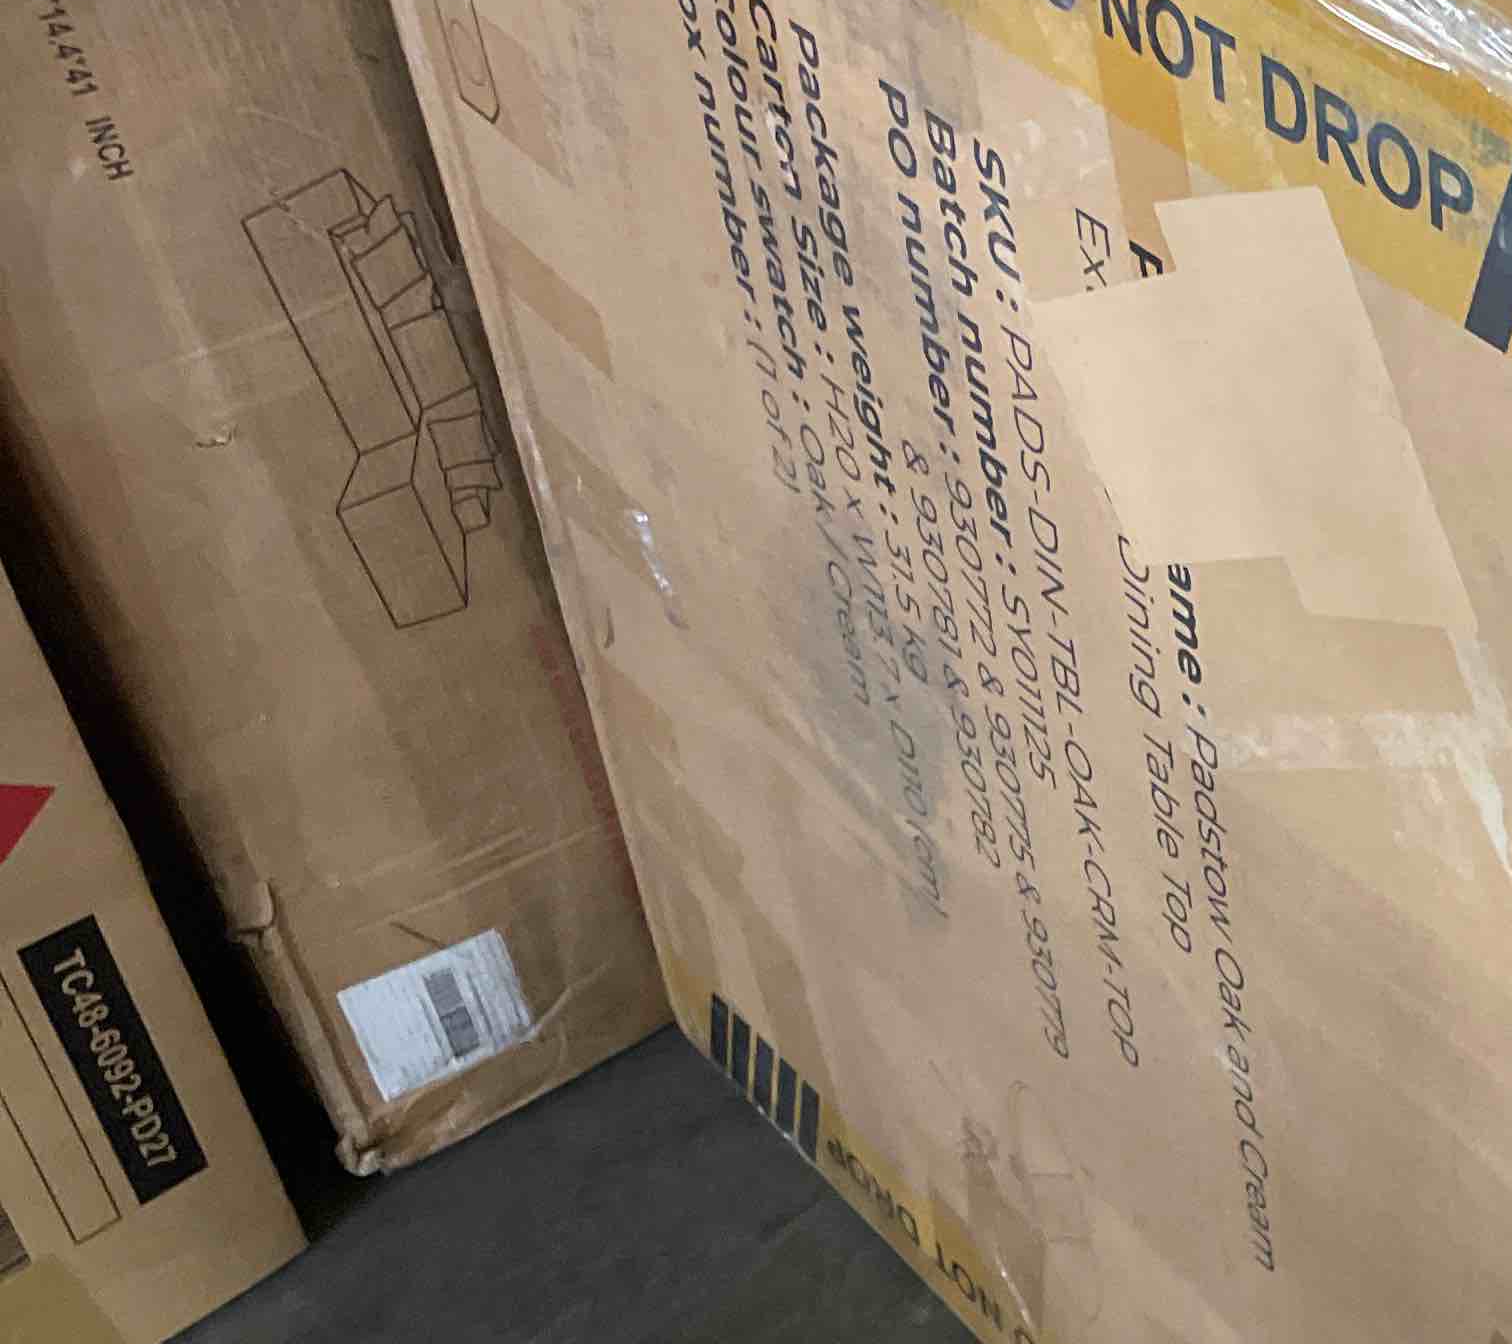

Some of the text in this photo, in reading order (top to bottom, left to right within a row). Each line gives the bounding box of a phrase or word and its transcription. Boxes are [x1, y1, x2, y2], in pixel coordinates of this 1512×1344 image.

[85, 115, 134, 182] INCH
[878, 78, 919, 181] PO
[1259, 53, 1475, 233] DROP
[694, 71, 757, 304] number
[761, 389, 793, 450] of
[788, 17, 855, 289] Package
[842, 304, 897, 496] weight
[883, 529, 921, 622] 31.5
[897, 191, 958, 438] number
[925, 109, 979, 297] Batch
[953, 309, 1012, 549] number
[750, 175, 808, 381] swatch
[799, 423, 836, 522] Oak
[827, 559, 871, 708] Cream
[820, 372, 861, 482] H20
[944, 472, 997, 657] 930772
[973, 138, 1021, 282] SKU
[1000, 326, 1139, 1067] PADS-DIN-TBL-OAK-CRM-TOP
[1166, 562, 1203, 685] ame
[910, 488, 963, 659] 930781
[950, 703, 1001, 869] 930782
[984, 705, 1037, 874] 930775
[1139, 730, 1182, 861] Table
[1184, 728, 1233, 946] Padstow
[1019, 911, 1069, 1060] 930779
[1159, 864, 1194, 955] Top
[53, 948, 177, 1168] TC48-6092-PD27
[1214, 946, 1250, 1050] Oak
[1226, 1045, 1260, 1138] and
[825, 1136, 921, 1258] DROP
[1236, 1137, 1275, 1272] Cream
[934, 1244, 1004, 1331] NOT
